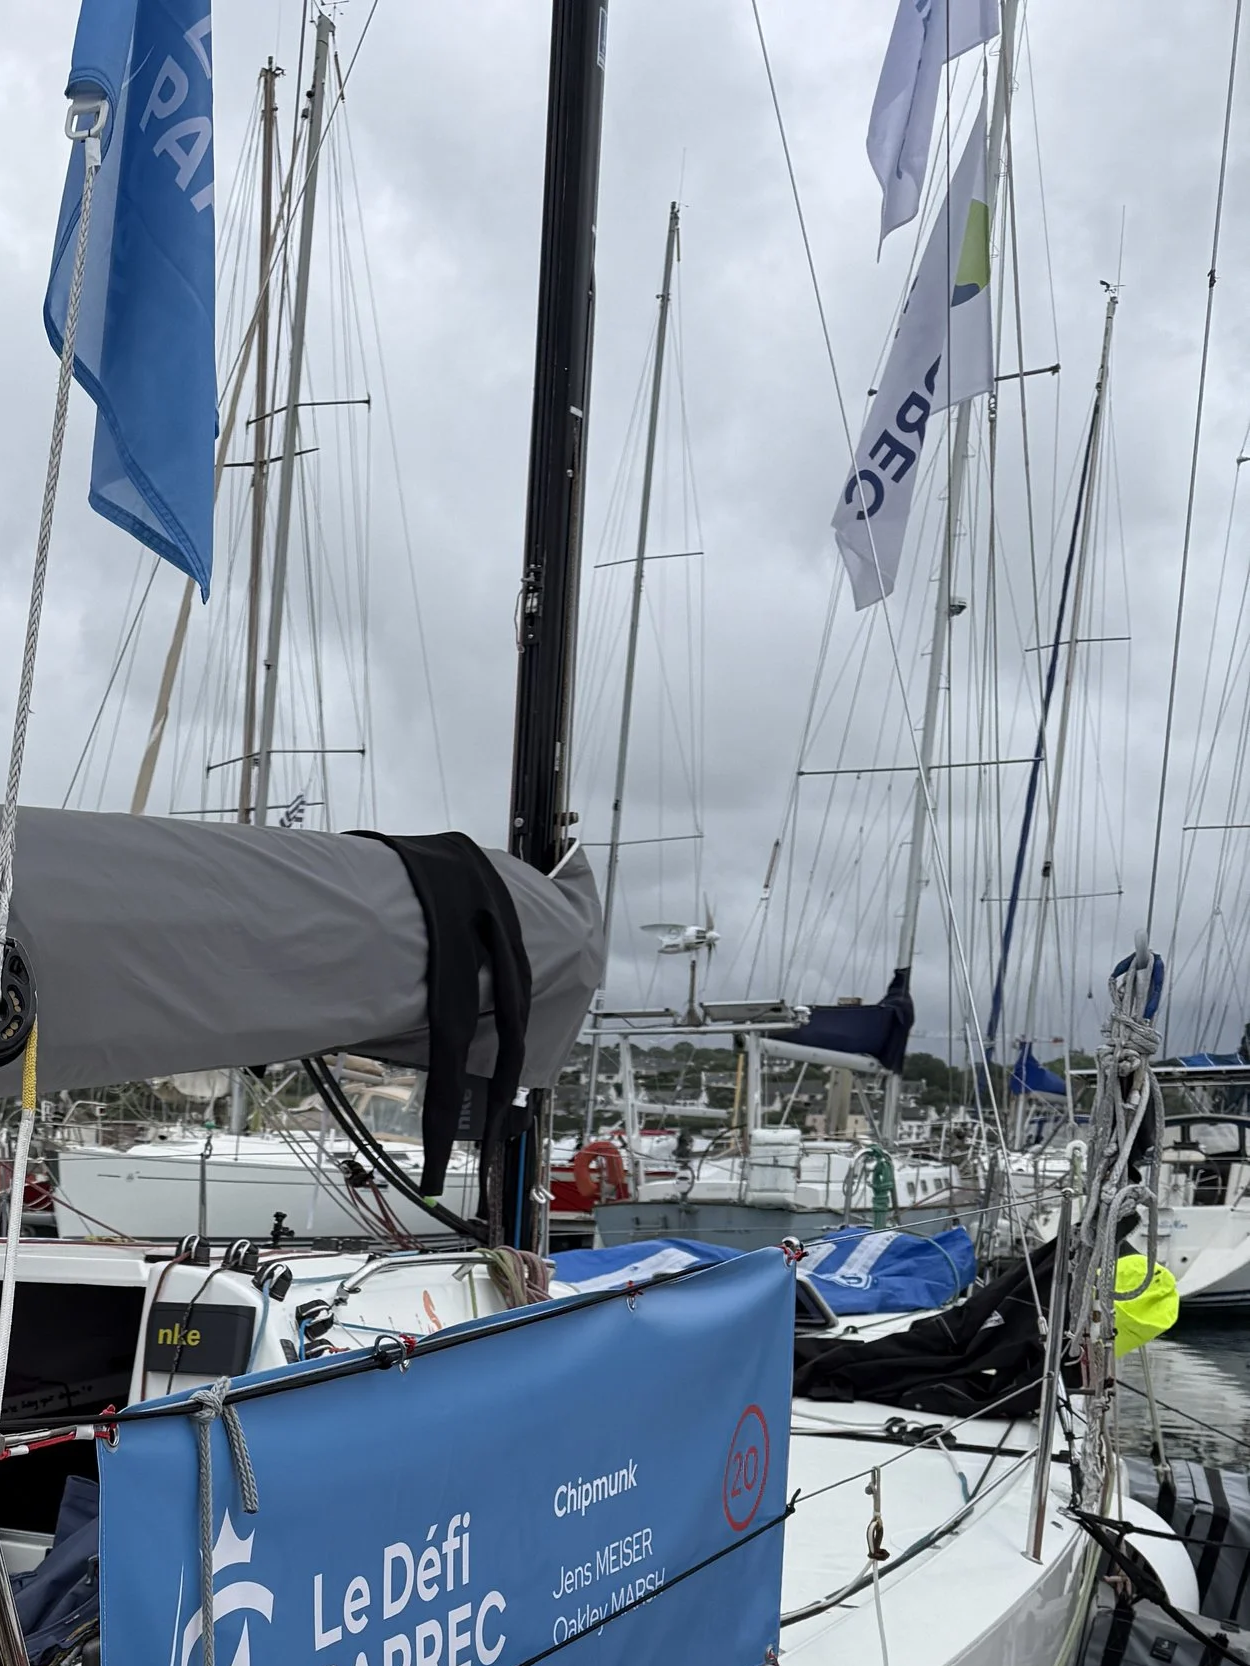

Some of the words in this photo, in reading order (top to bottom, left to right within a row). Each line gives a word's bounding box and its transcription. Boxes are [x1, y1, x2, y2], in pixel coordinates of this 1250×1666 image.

[158, 1323, 201, 1346] nke
[554, 1458, 638, 1518] Chipmunk
[731, 1445, 758, 1498] 20
[314, 1573, 371, 1651] Le
[383, 1511, 471, 1620] Défi
[552, 1562, 592, 1600] Jens
[596, 1527, 653, 1581] MEISER
[553, 1604, 608, 1646] Oakley
[610, 1567, 665, 1621] MARSH
